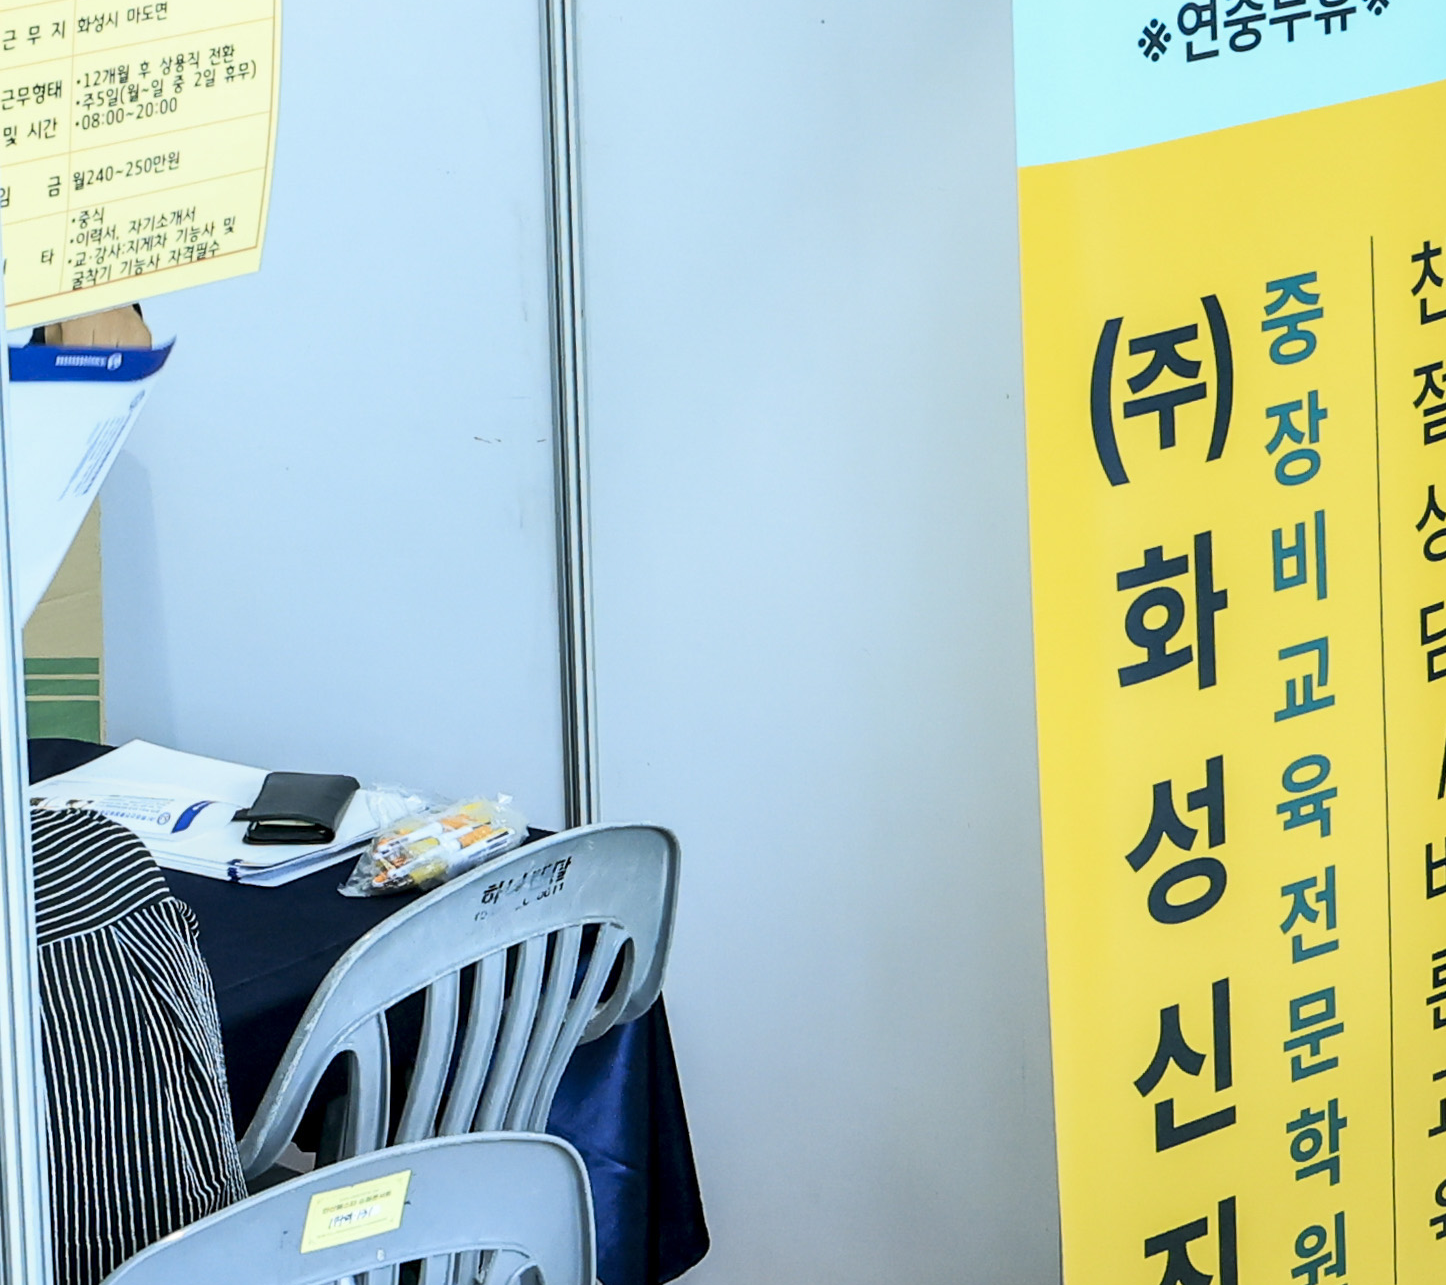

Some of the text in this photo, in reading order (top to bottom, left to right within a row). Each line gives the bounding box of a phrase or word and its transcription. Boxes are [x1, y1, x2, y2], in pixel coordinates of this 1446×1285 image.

[77, 1, 168, 35] 화성시 마도면
[160, 51, 200, 74] 상용직
[209, 44, 236, 66] 전환
[173, 77, 186, 94] 중
[194, 68, 216, 89] 2일
[224, 60, 258, 82] 휴무)
[1, 80, 62, 111] 근무형태
[4, 118, 58, 148] 및 시간
[48, 177, 62, 198] 금
[129, 206, 197, 235] 자기소개서
[177, 224, 215, 244] 기능사
[41, 249, 54, 265] 타
[72, 240, 220, 291] 굴착기 기능사 자격필수
